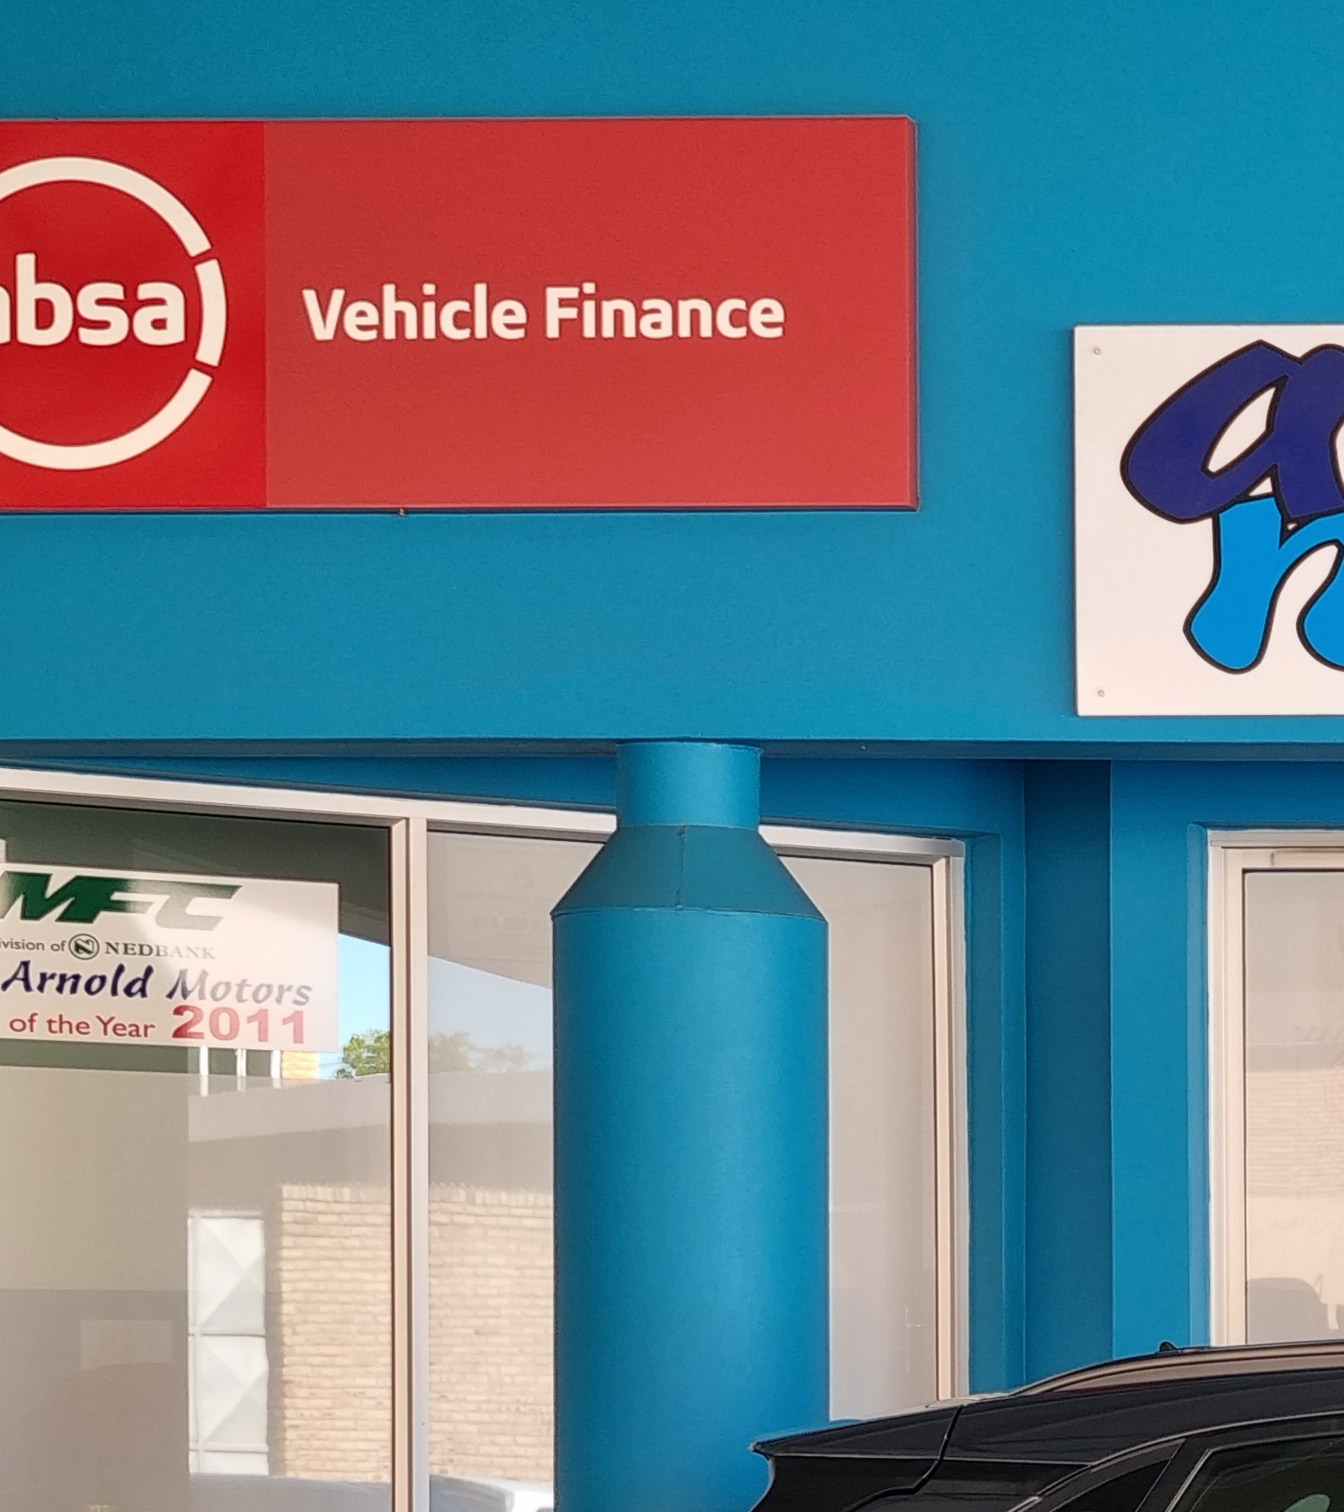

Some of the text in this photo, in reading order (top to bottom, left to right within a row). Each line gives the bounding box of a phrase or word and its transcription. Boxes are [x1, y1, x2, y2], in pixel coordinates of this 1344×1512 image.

[0, 252, 186, 347] bsa
[302, 281, 786, 342] Vehicle Finance
[0, 870, 243, 931] MFC
[50, 940, 67, 952] of
[104, 941, 216, 960] NEDBANK
[1, 959, 314, 1006] Arnold Motors
[9, 1005, 305, 1044] of the Year 2011
